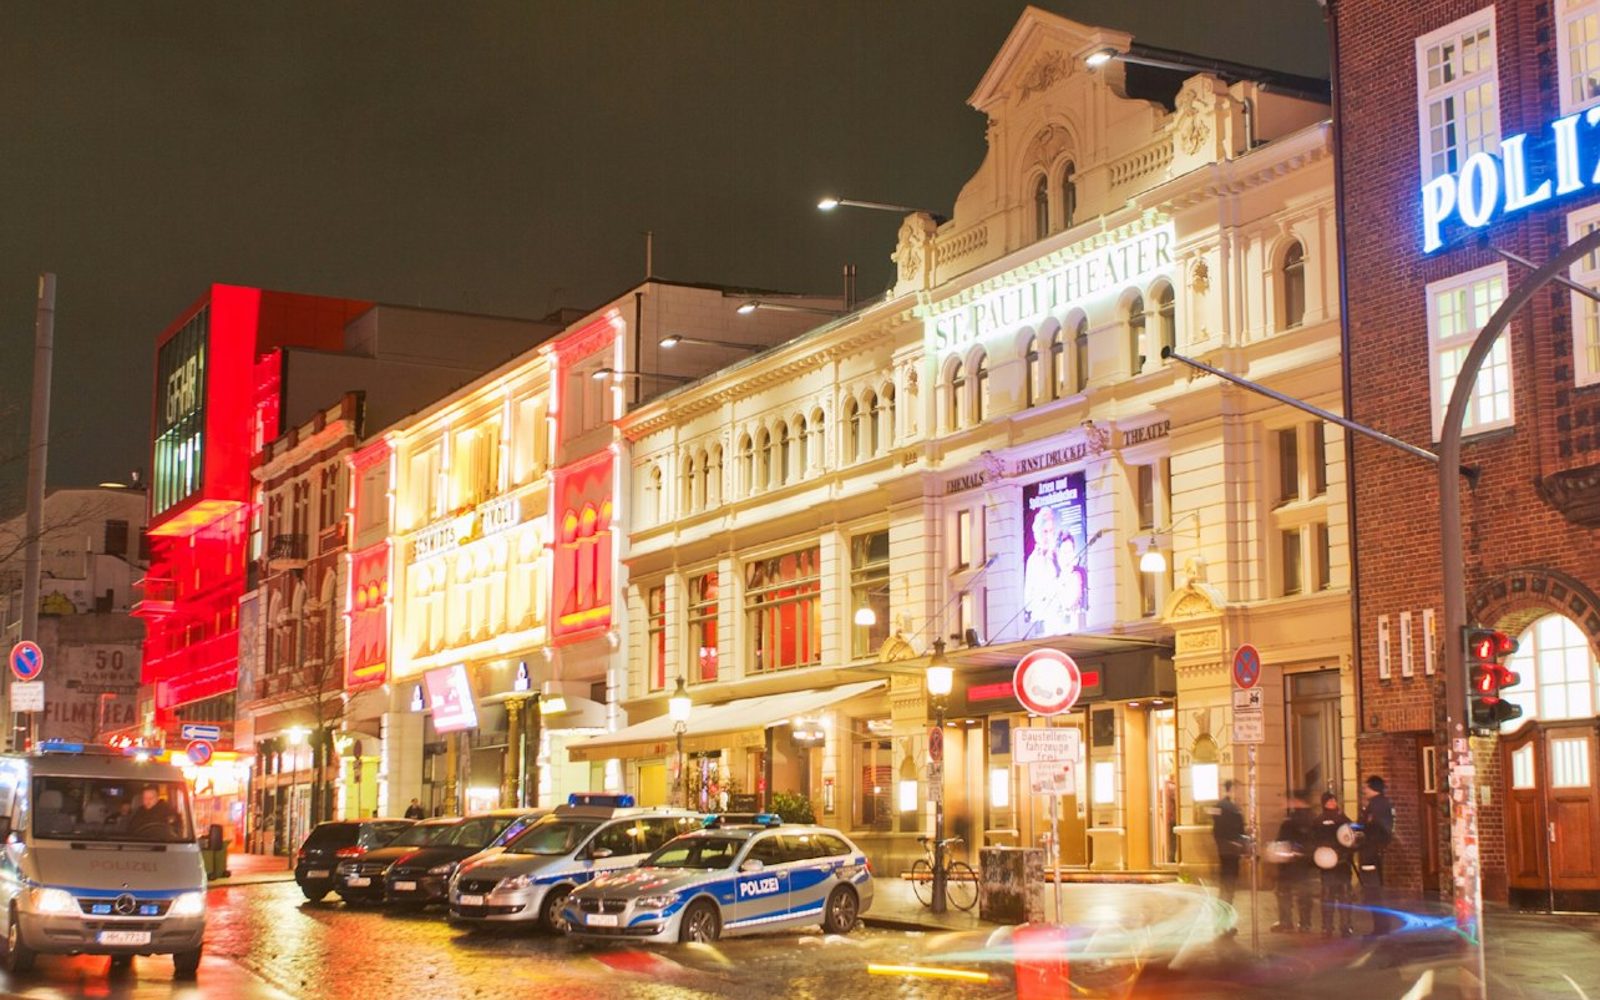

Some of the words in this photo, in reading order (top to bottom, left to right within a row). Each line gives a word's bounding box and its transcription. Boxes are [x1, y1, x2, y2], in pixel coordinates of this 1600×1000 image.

[936, 312, 969, 351] ST.
[974, 282, 1040, 338] PAULI
[1048, 230, 1173, 308] THEATER
[1124, 419, 1171, 447] THEATER
[95, 650, 124, 670] 50
[1026, 742, 1069, 755] fahrzeuge
[89, 860, 158, 872] POLIZEI
[739, 877, 780, 897] POLIZEI
